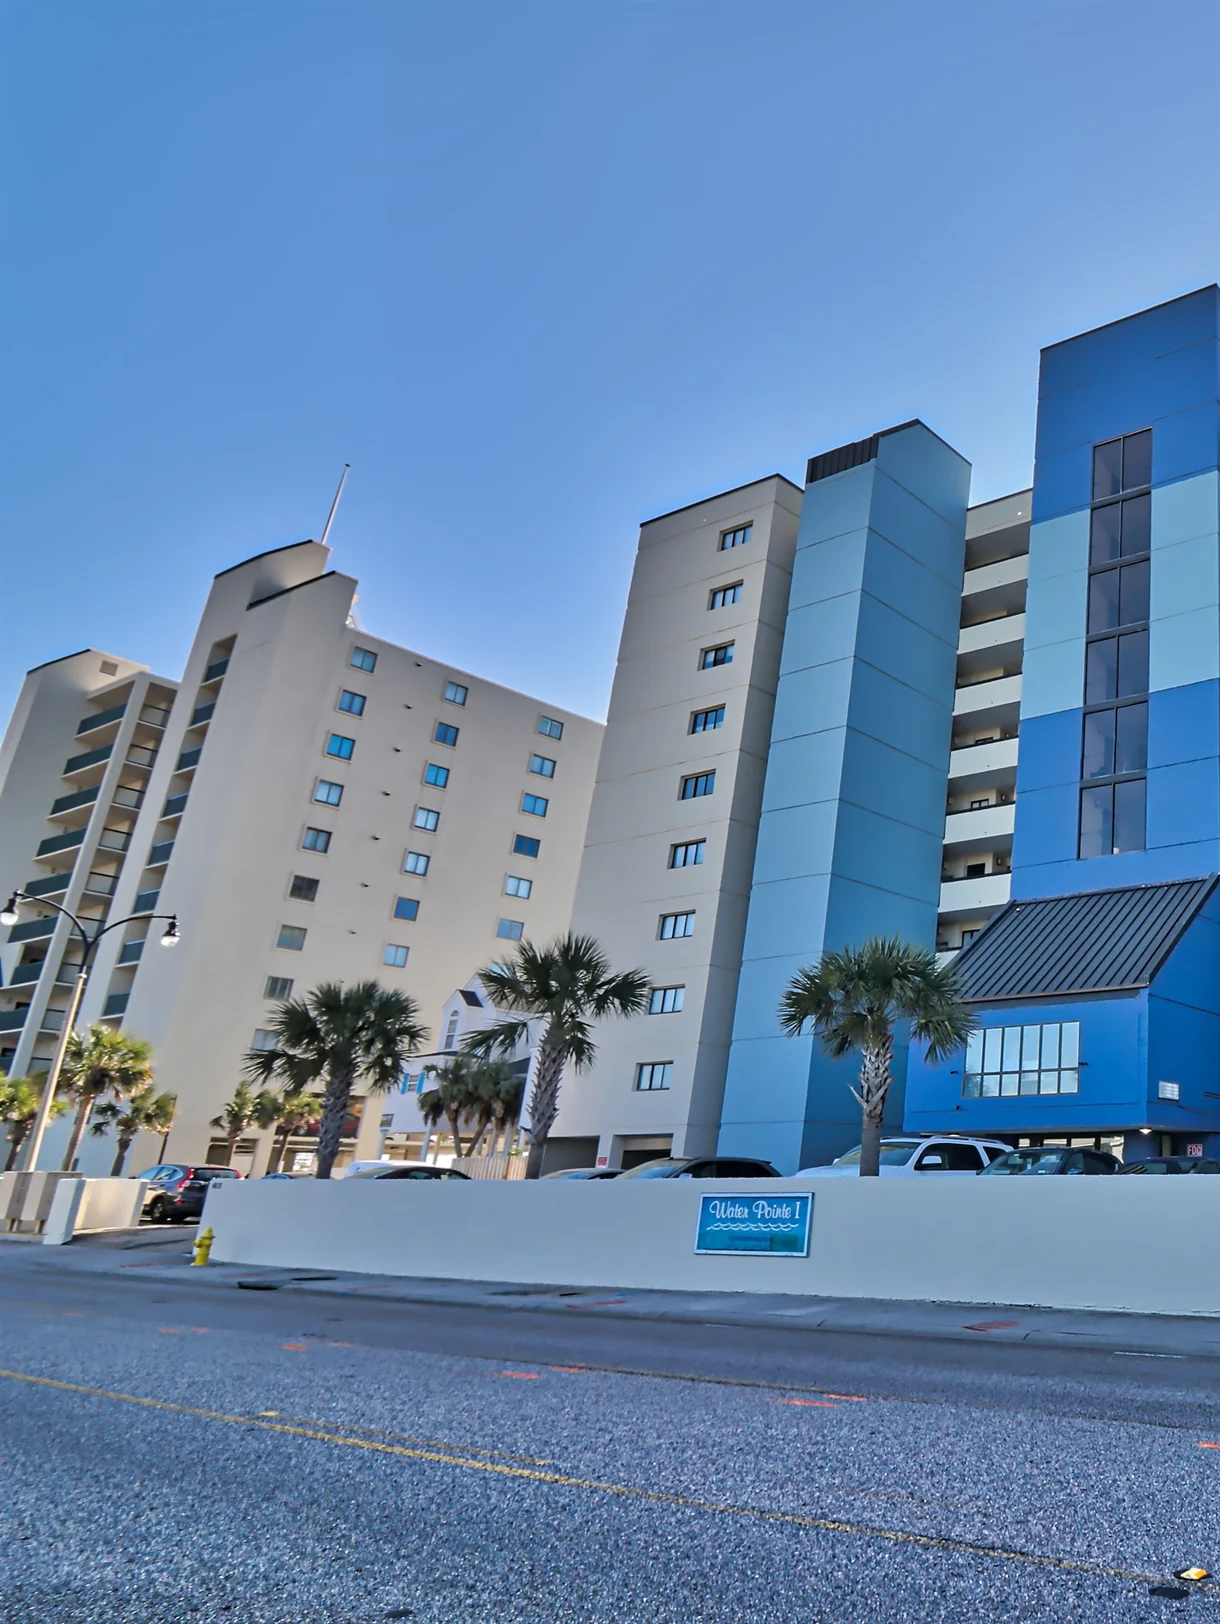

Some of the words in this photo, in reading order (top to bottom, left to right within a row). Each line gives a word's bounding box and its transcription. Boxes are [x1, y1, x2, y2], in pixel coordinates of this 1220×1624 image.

[709, 1200, 748, 1219] Water
[752, 1200, 791, 1219] Pointe
[794, 1201, 801, 1219] I
